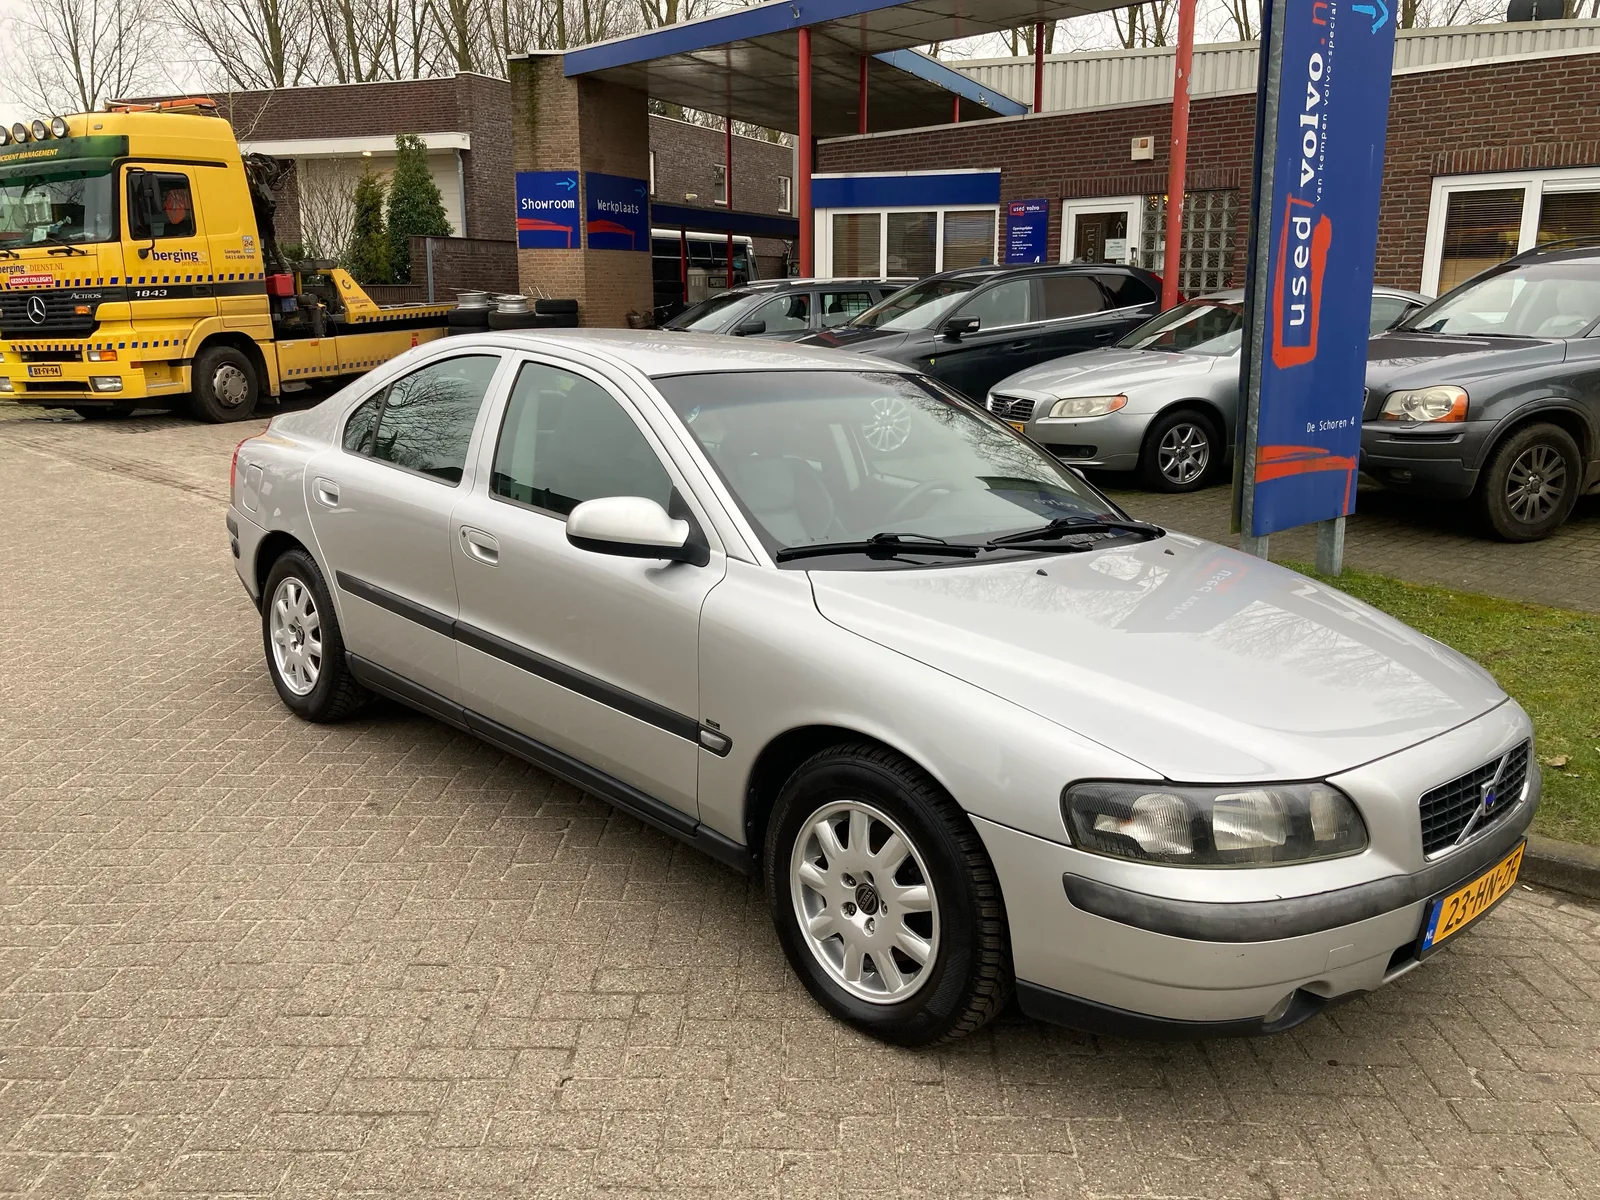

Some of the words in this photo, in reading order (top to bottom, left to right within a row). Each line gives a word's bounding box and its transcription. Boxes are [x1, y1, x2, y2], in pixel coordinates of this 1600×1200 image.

[1317, 113, 1328, 171] kempen
[0, 153, 19, 162] CIDENT
[19, 148, 59, 159] MANAGEMENT
[521, 198, 575, 210] Showroom
[597, 199, 640, 215] Werkplaats
[152, 249, 200, 263] berging
[29, 263, 65, 272] DIENST.NL
[1289, 216, 1311, 326] used
[135, 289, 168, 297] 1843
[1306, 422, 1316, 433] De
[1319, 419, 1347, 432] Schoren
[1350, 416, 1355, 426] 4
[1442, 850, 1521, 934] 23-HN-ZF
